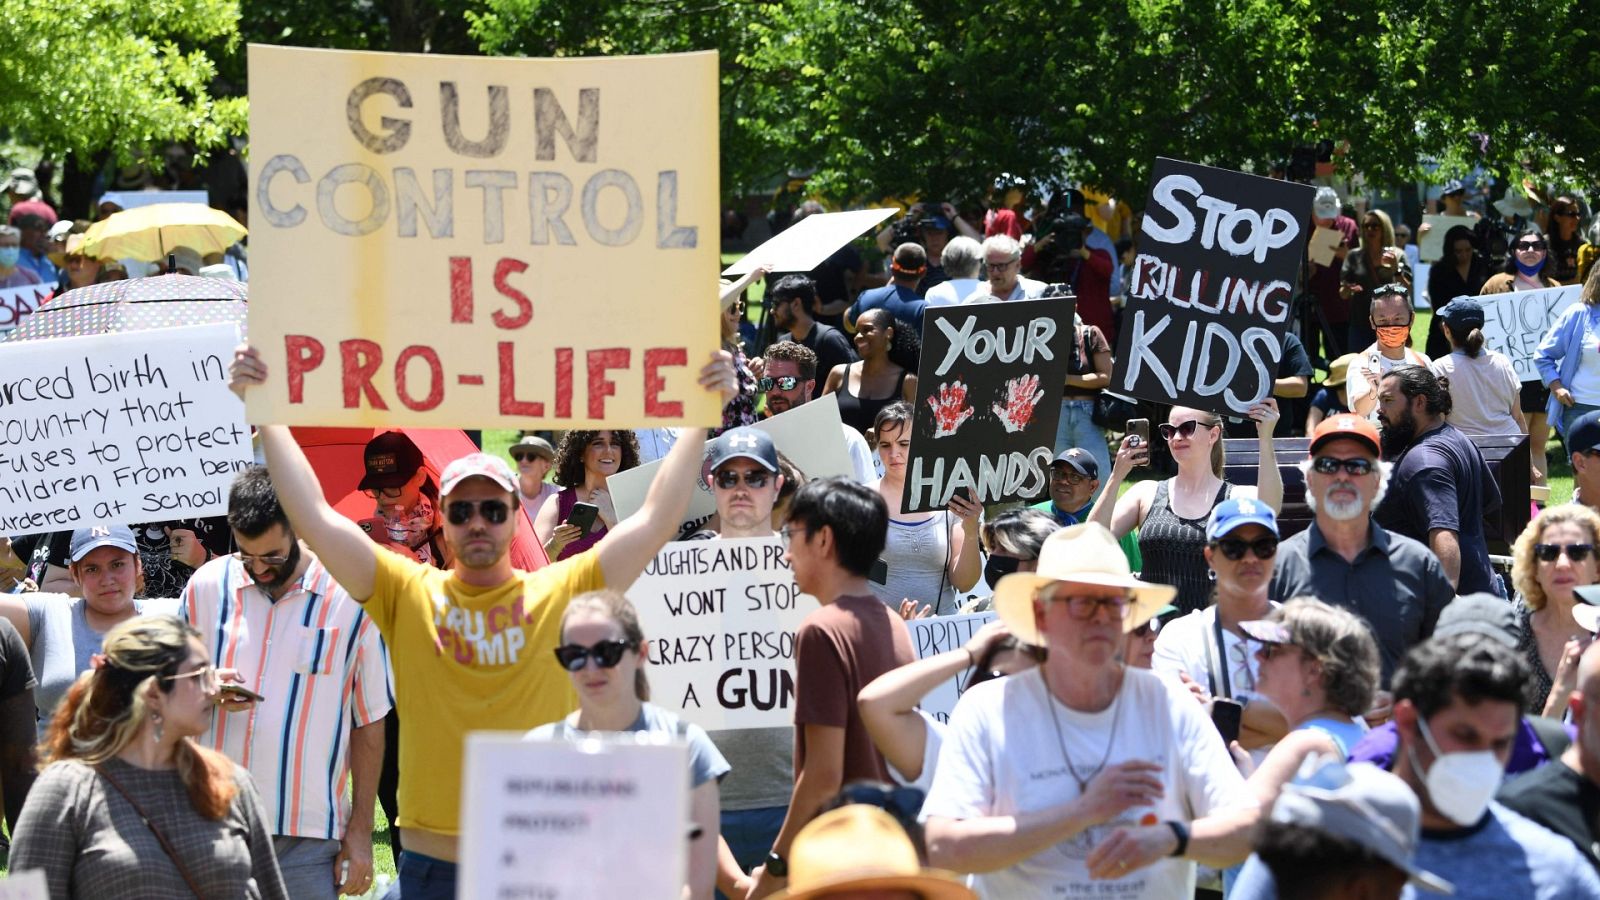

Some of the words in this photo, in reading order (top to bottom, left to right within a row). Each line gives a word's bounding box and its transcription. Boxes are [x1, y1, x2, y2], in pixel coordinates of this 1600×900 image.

[346, 76, 600, 163] GUN
[256, 153, 698, 249] CONTROL
[1141, 174, 1300, 263] STOP
[449, 255, 534, 330] IS
[1130, 253, 1292, 323] KILLING
[85, 353, 168, 393] birth
[189, 350, 224, 382] in
[934, 315, 1059, 376] YOUR
[1124, 310, 1282, 414] KIDS
[284, 334, 688, 420] PRO-LIFE
[120, 391, 193, 426] that
[88, 441, 120, 465] to
[136, 423, 243, 470] protect
[93, 500, 127, 518] at
[910, 446, 1053, 511] HANDS
[712, 546, 758, 573] AND
[763, 545, 791, 570] PR
[664, 588, 727, 616] WONT
[745, 581, 801, 612] STOP
[648, 634, 715, 665] CRAZY
[682, 682, 701, 709] A
